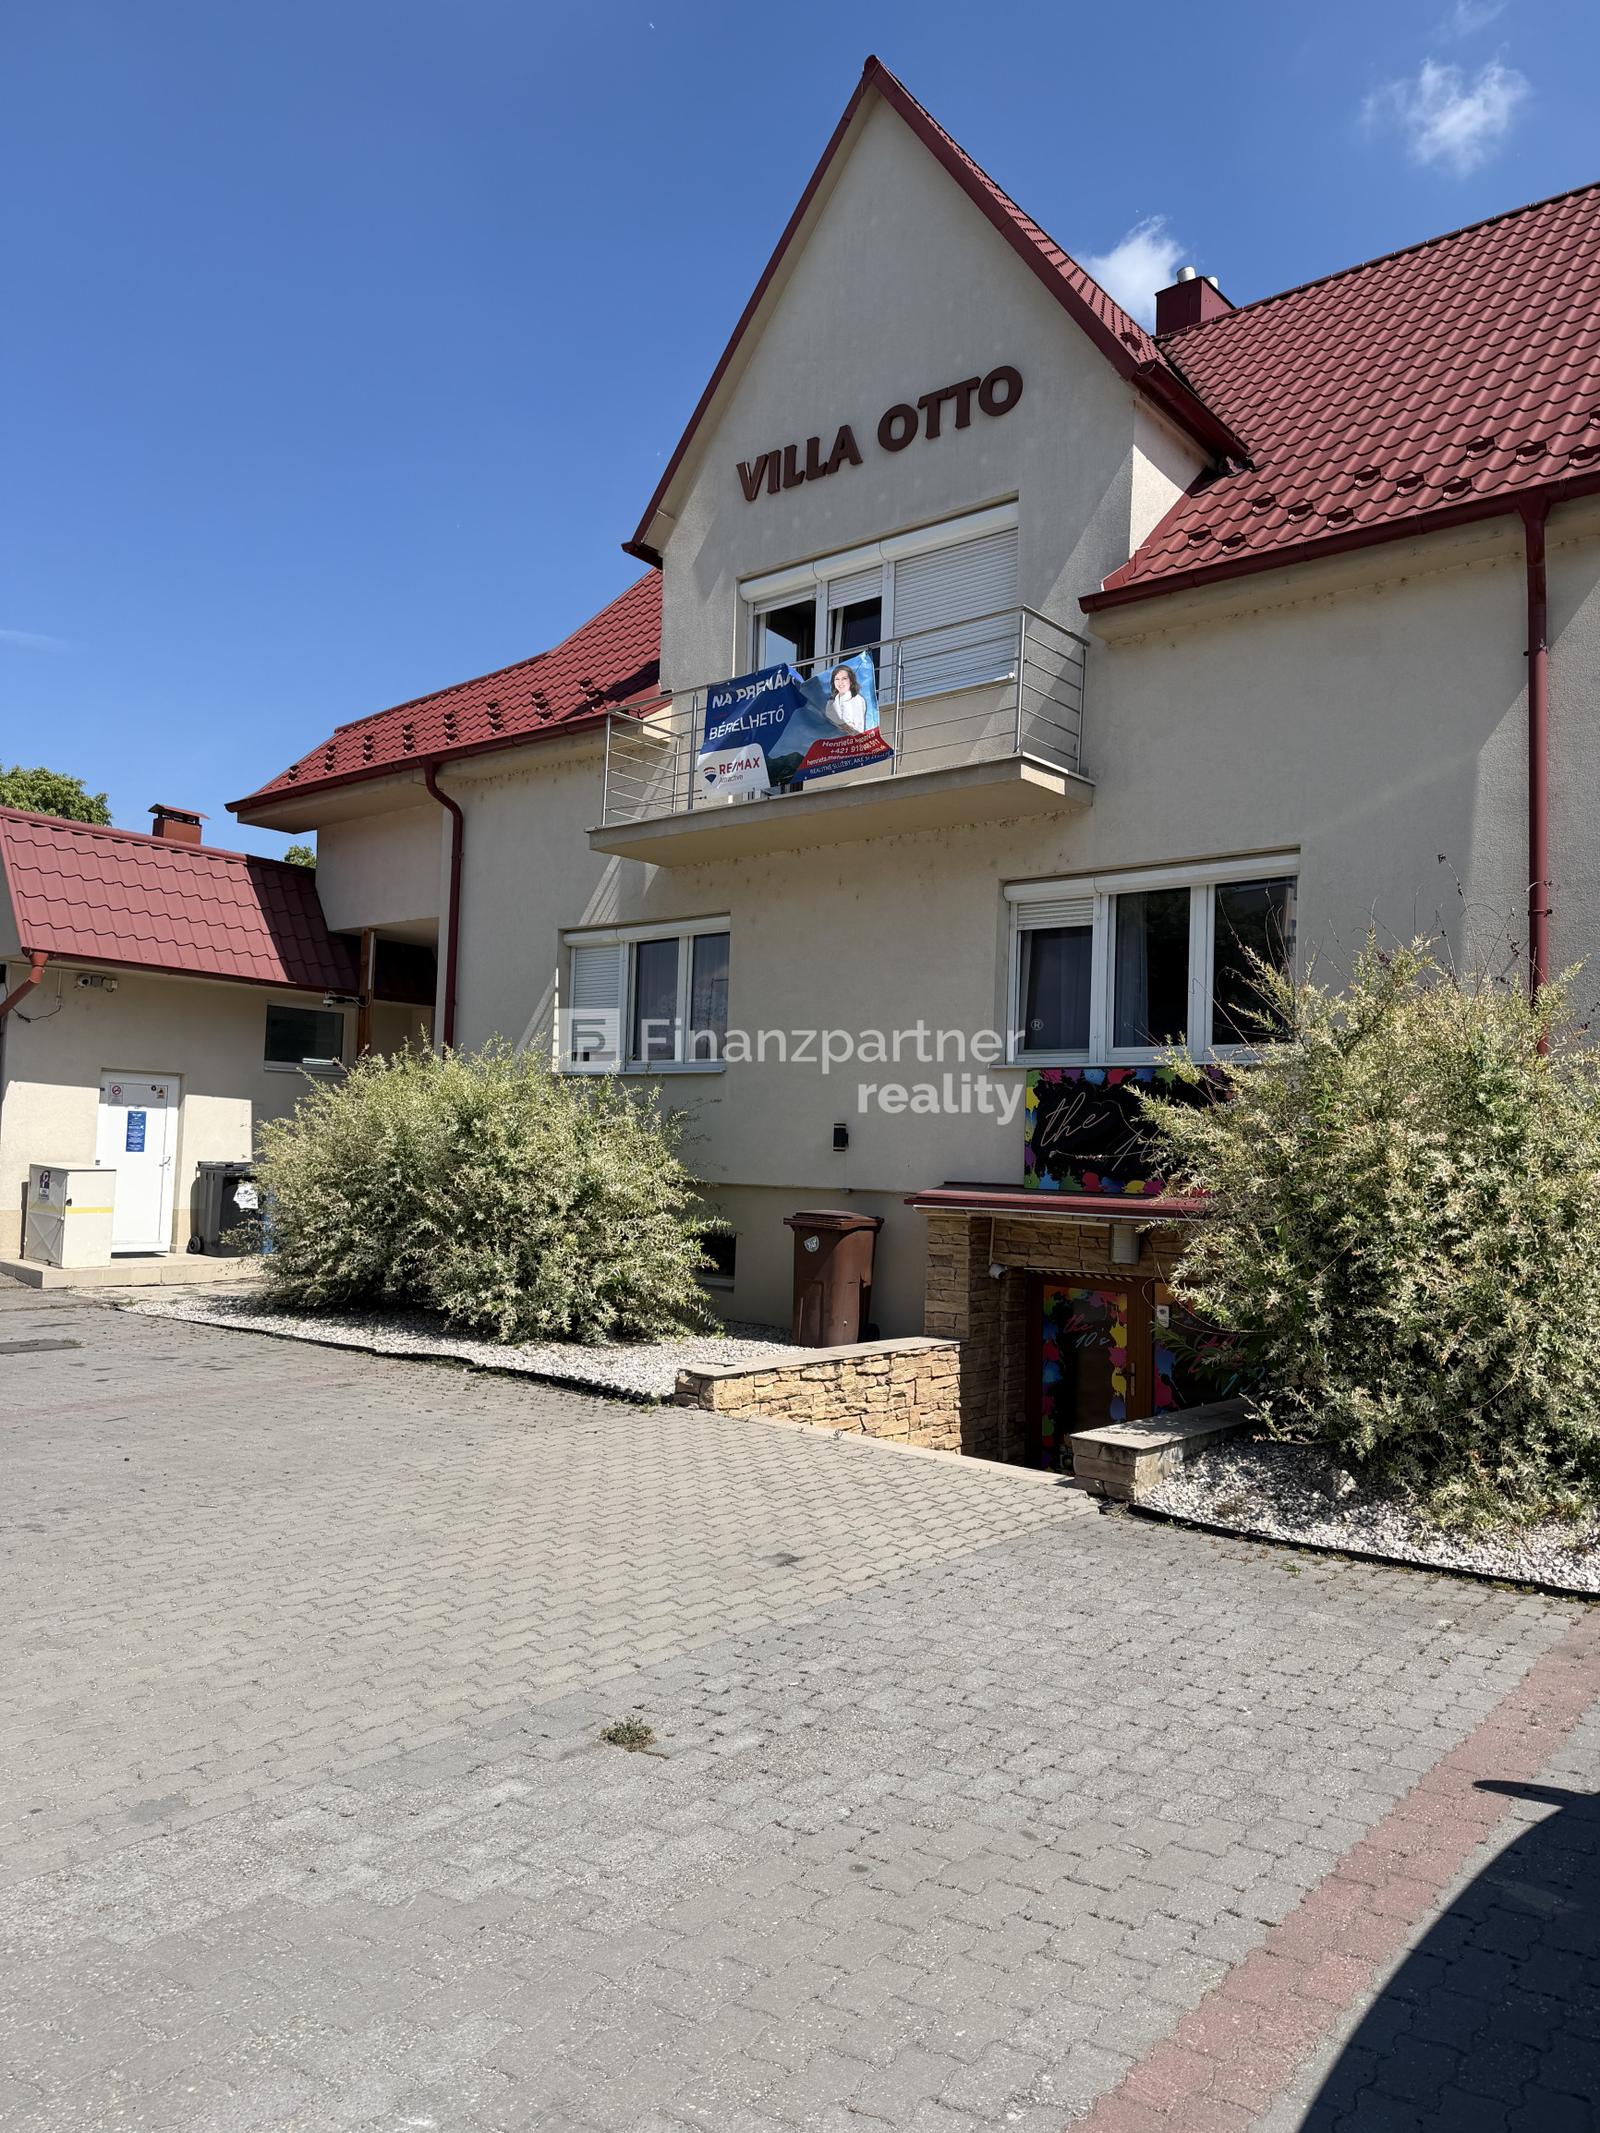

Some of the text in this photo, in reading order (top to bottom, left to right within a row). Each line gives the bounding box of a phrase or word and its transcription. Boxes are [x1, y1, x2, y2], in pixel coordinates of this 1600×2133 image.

[736, 365, 1024, 502] VILLA OTTO
[712, 692, 733, 709] NA
[709, 704, 785, 741] BÉRELHETŐ
[719, 757, 761, 775] RE/MAX
[1040, 1091, 1111, 1147] the
